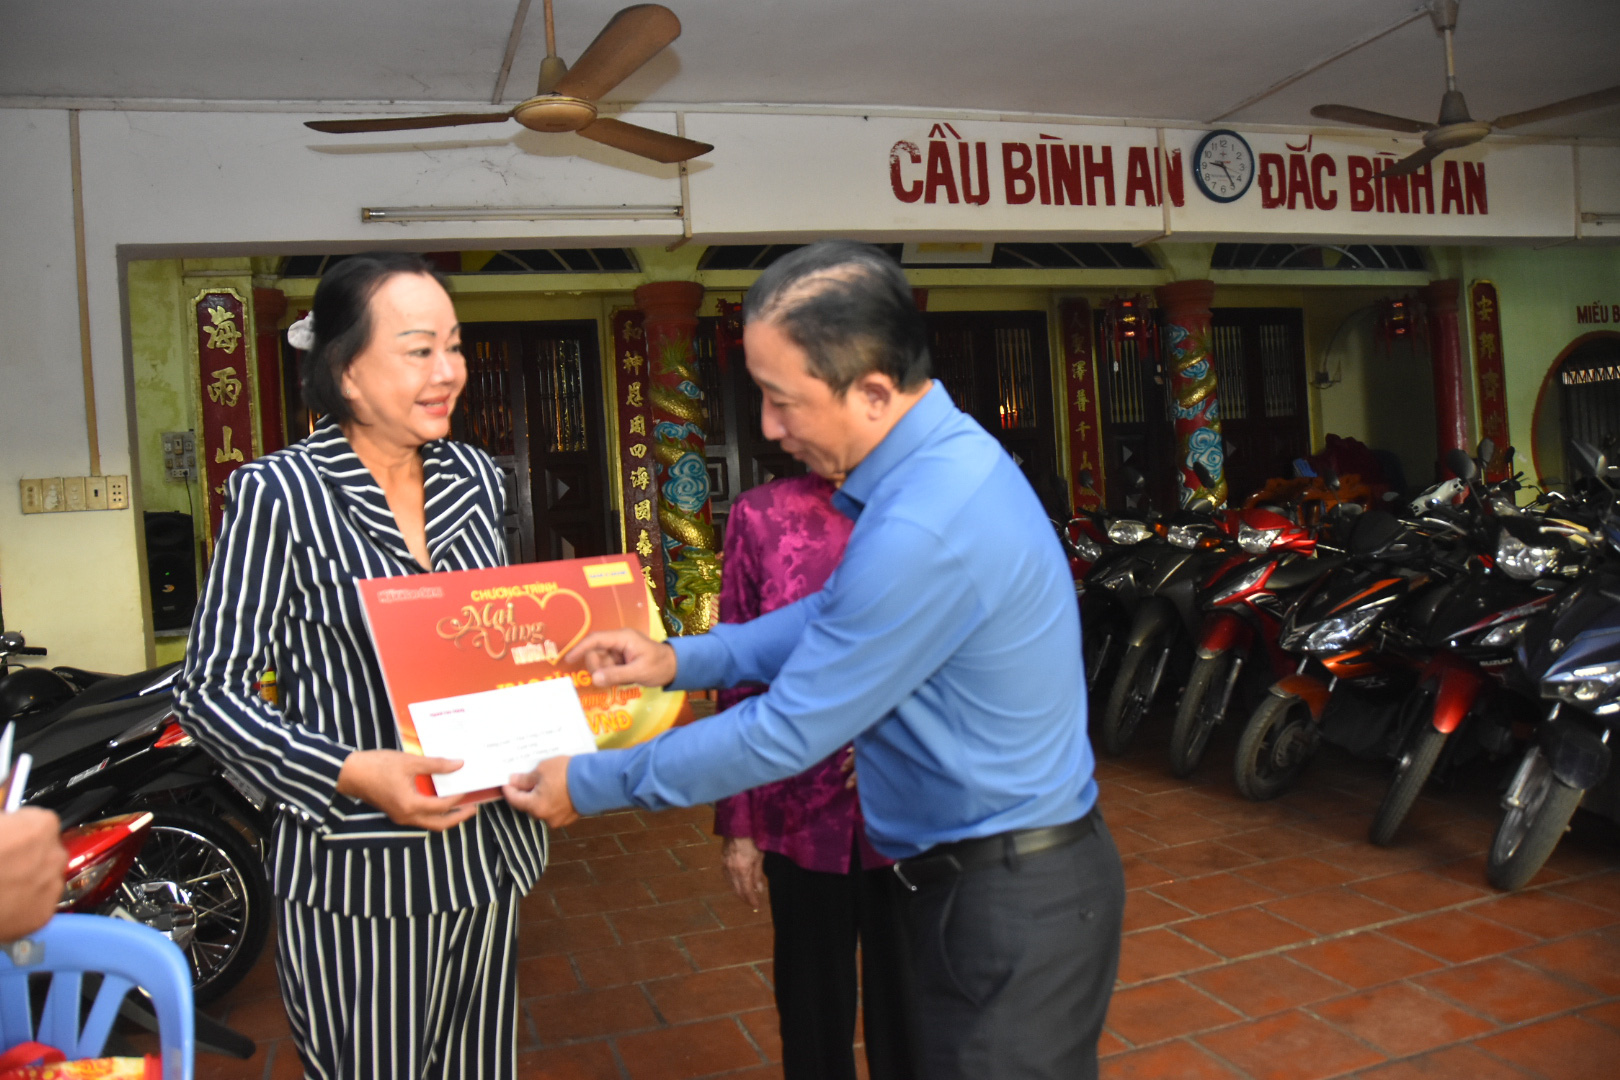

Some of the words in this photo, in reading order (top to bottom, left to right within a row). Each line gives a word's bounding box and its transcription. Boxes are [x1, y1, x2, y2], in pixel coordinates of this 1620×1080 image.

[1212, 142, 1218, 150] 11
[1220, 140, 1228, 148] 12
[1204, 150, 1212, 158] 10
[1236, 152, 1242, 160] 2
[890, 122, 990, 205] CẦU
[1002, 133, 1116, 206] BÌNH
[1125, 146, 1185, 207] AN
[1202, 162, 1208, 170] 9
[1239, 163, 1245, 171] 3
[1204, 172, 1210, 182] 8
[1236, 174, 1242, 182] 4
[1258, 134, 1338, 211] ĐẮC
[1347, 151, 1435, 214] BÌNH
[1441, 160, 1488, 215] AN
[1220, 185, 1226, 194] 6
[1479, 657, 1513, 667] SUZUKI
